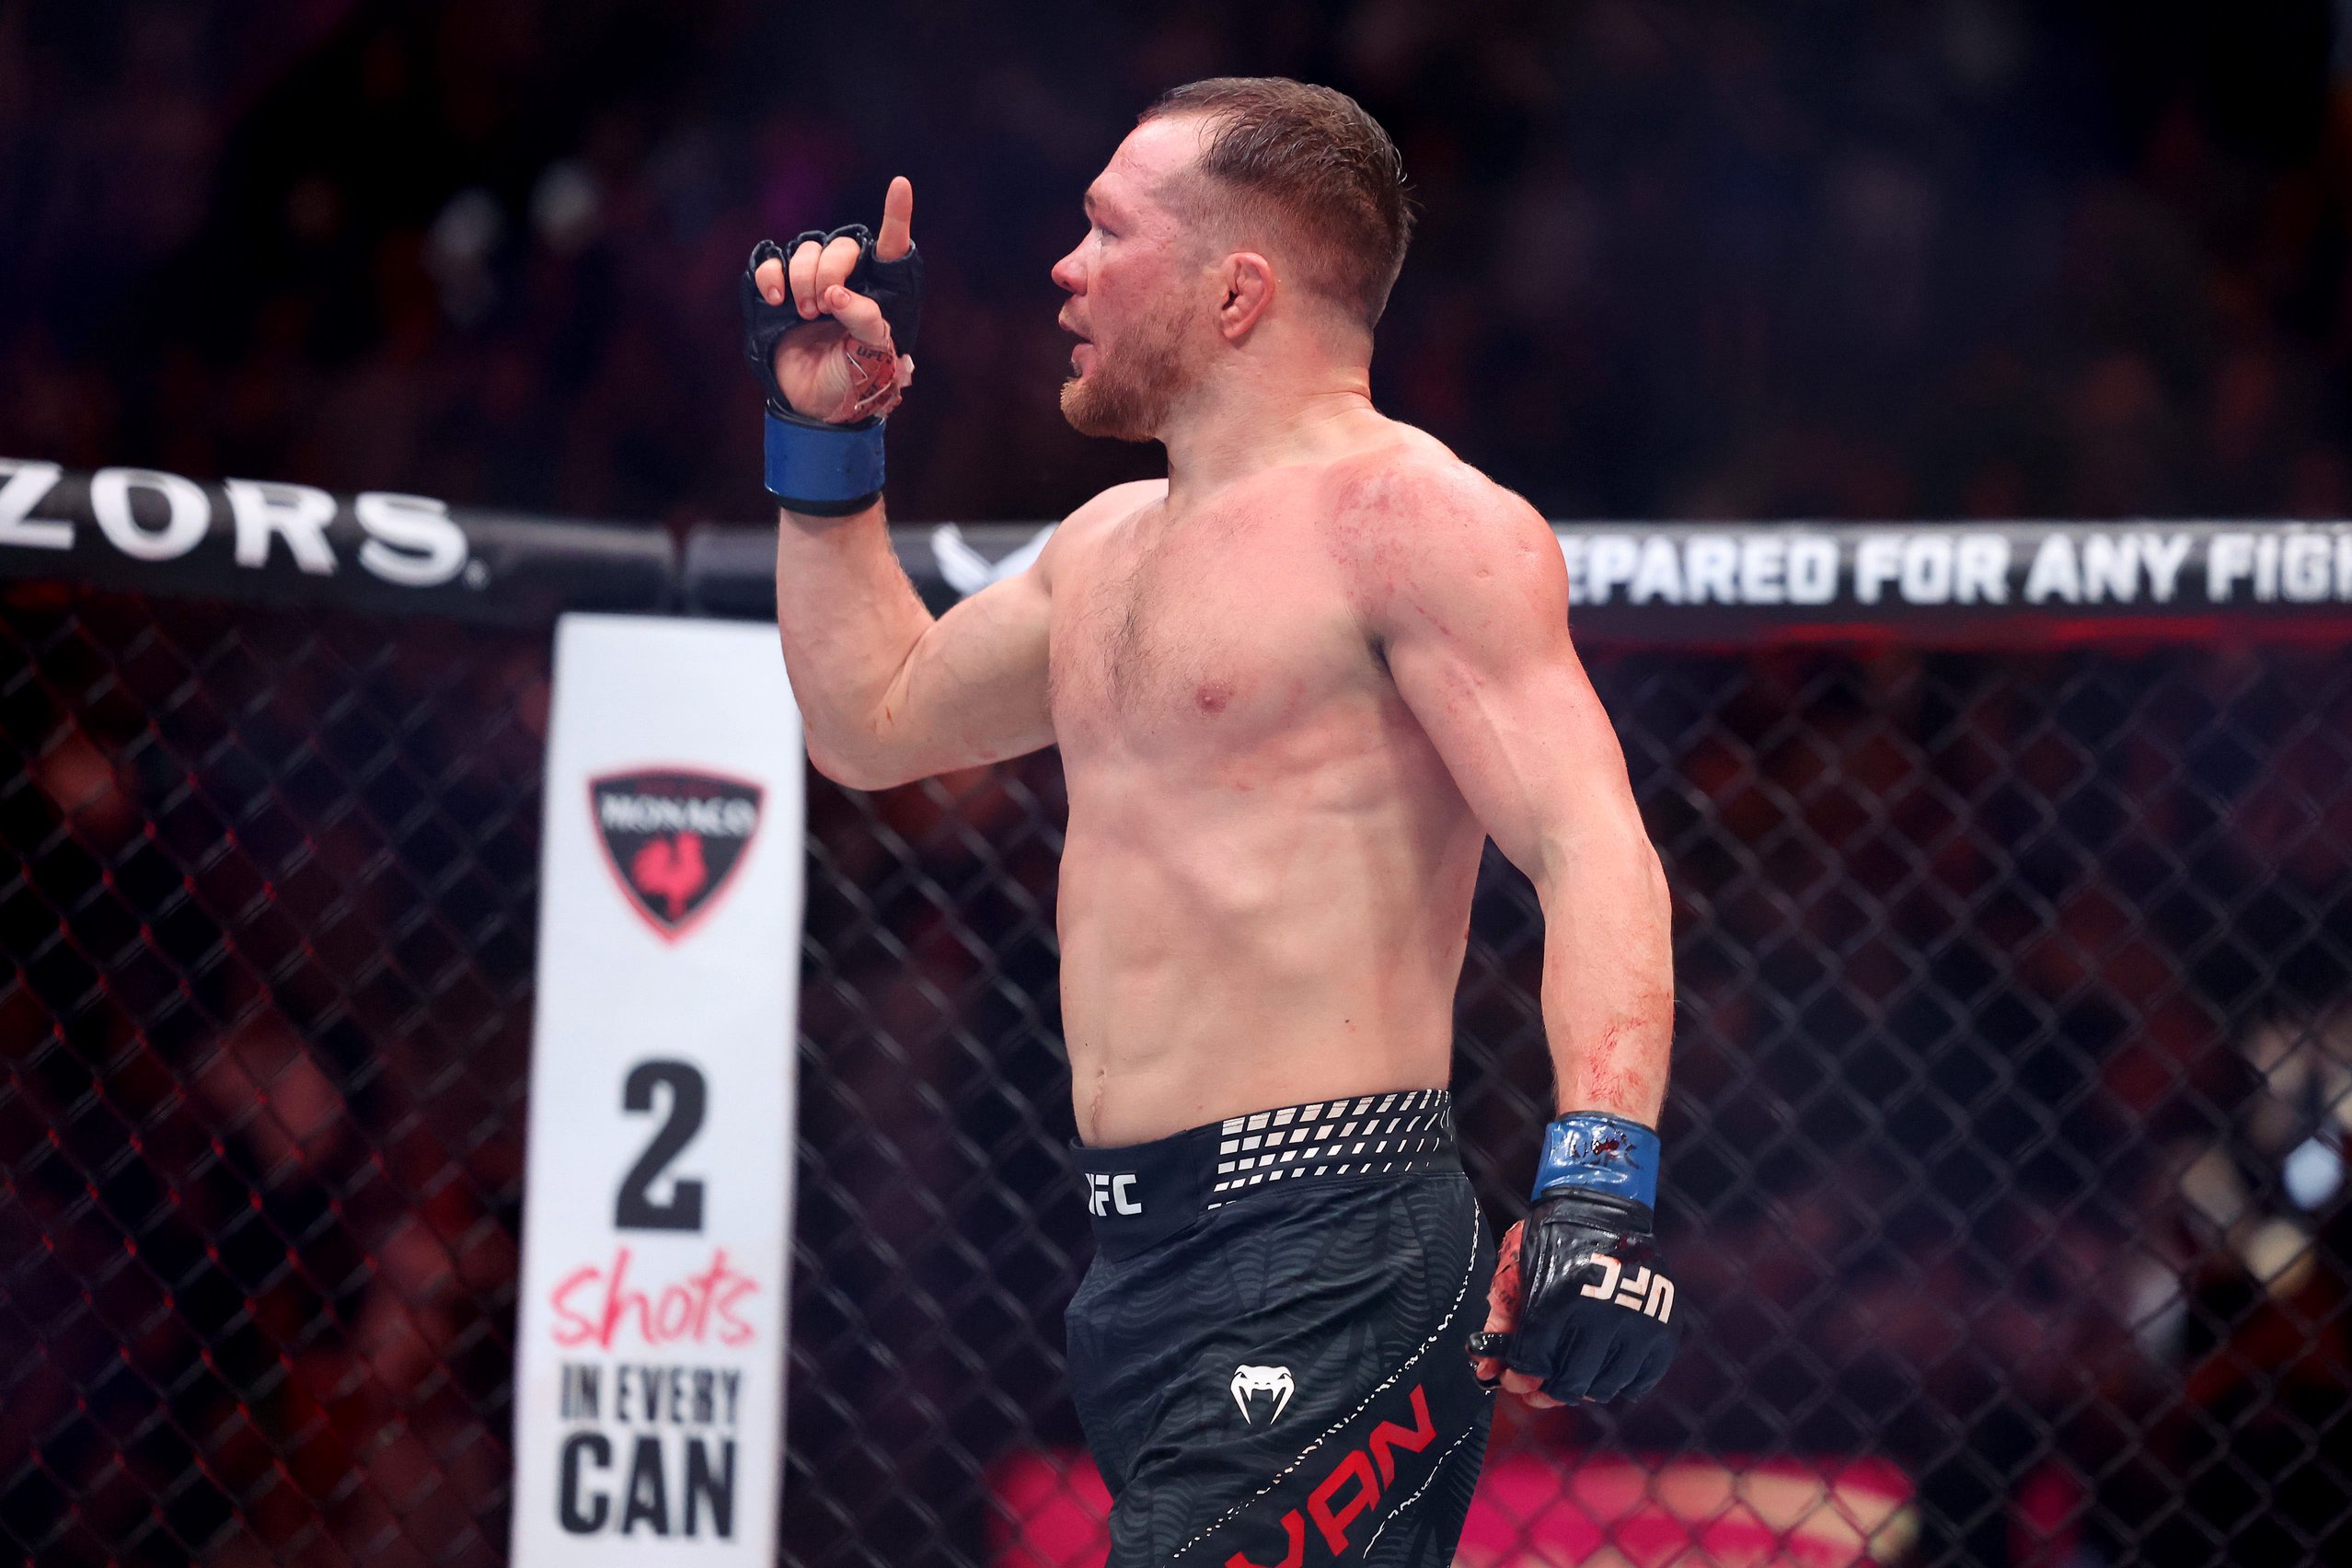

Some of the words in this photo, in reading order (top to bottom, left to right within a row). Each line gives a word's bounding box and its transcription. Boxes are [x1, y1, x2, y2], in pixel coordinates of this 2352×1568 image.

[1853, 534, 2012, 605] FOR
[2024, 533, 2193, 604] ANY
[601, 793, 755, 837] MONACO
[614, 1057, 707, 1231] 2
[550, 1247, 758, 1349] shots
[1580, 1253, 1674, 1324] UFC
[561, 1364, 600, 1420] IN
[616, 1365, 740, 1425] EVERY
[558, 1431, 737, 1539] CAN
